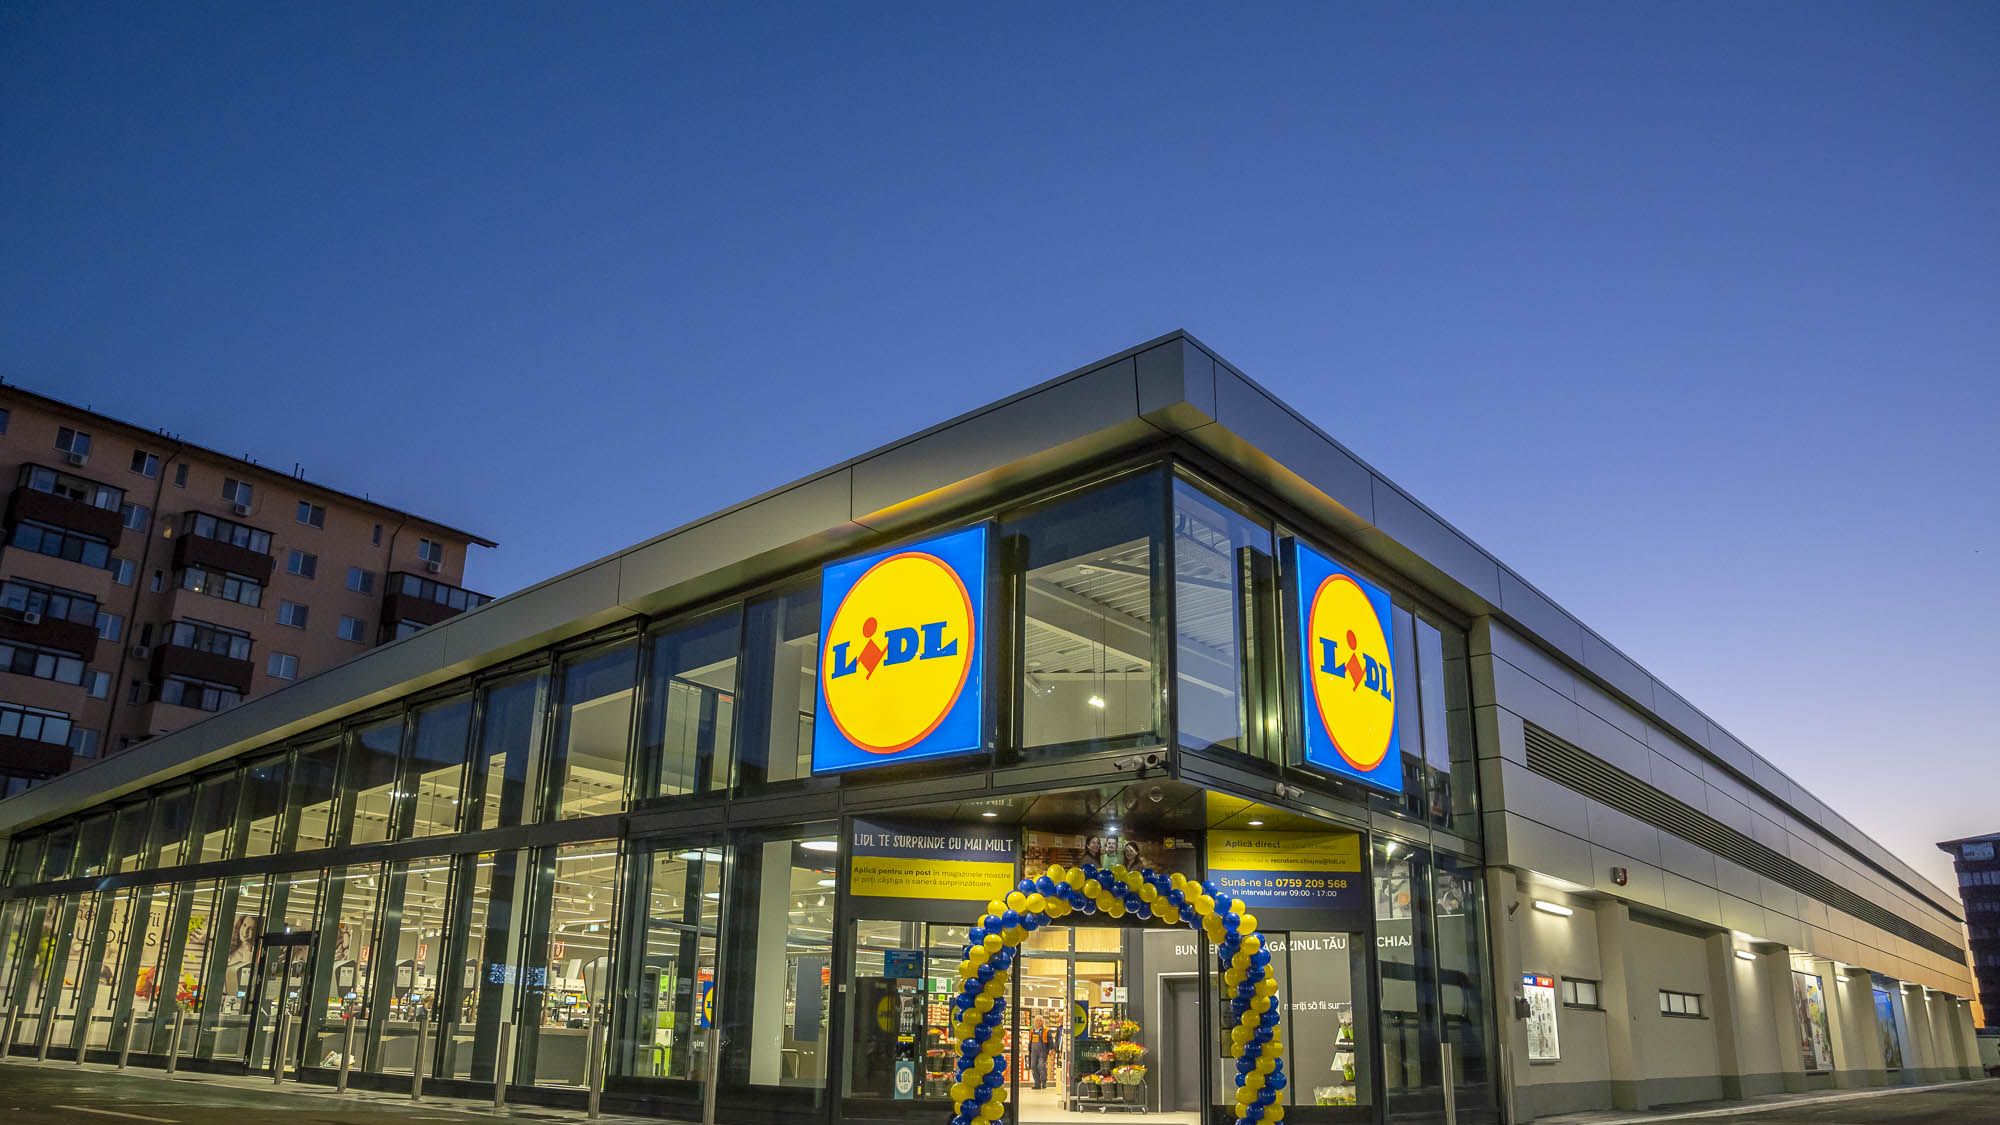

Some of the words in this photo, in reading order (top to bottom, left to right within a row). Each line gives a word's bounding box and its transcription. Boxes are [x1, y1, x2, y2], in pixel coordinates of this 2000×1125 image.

[854, 833, 875, 847] LIDL
[878, 834, 890, 847] TE
[893, 835, 946, 849] SURPRINDE
[948, 837, 961, 850] CU
[964, 838, 982, 851] MAI
[984, 839, 1014, 852] MULT
[1225, 840, 1252, 849] Aplică
[1255, 840, 1281, 849] direct
[853, 866, 876, 875] Aplică
[878, 868, 902, 876] pentru
[1220, 877, 1262, 887] Sună-ne
[1264, 878, 1273, 887] la
[1275, 878, 1302, 888] 0759
[1305, 879, 1325, 888] 209
[1327, 879, 1347, 889] 568
[1240, 889, 1272, 897] intervalul
[1289, 889, 1310, 897] 09:00
[1175, 945, 1198, 955] BUN
[1262, 939, 1322, 952] AGAZINUL
[1322, 936, 1346, 950] TĂU
[1377, 935, 1412, 948] CHIAJ
